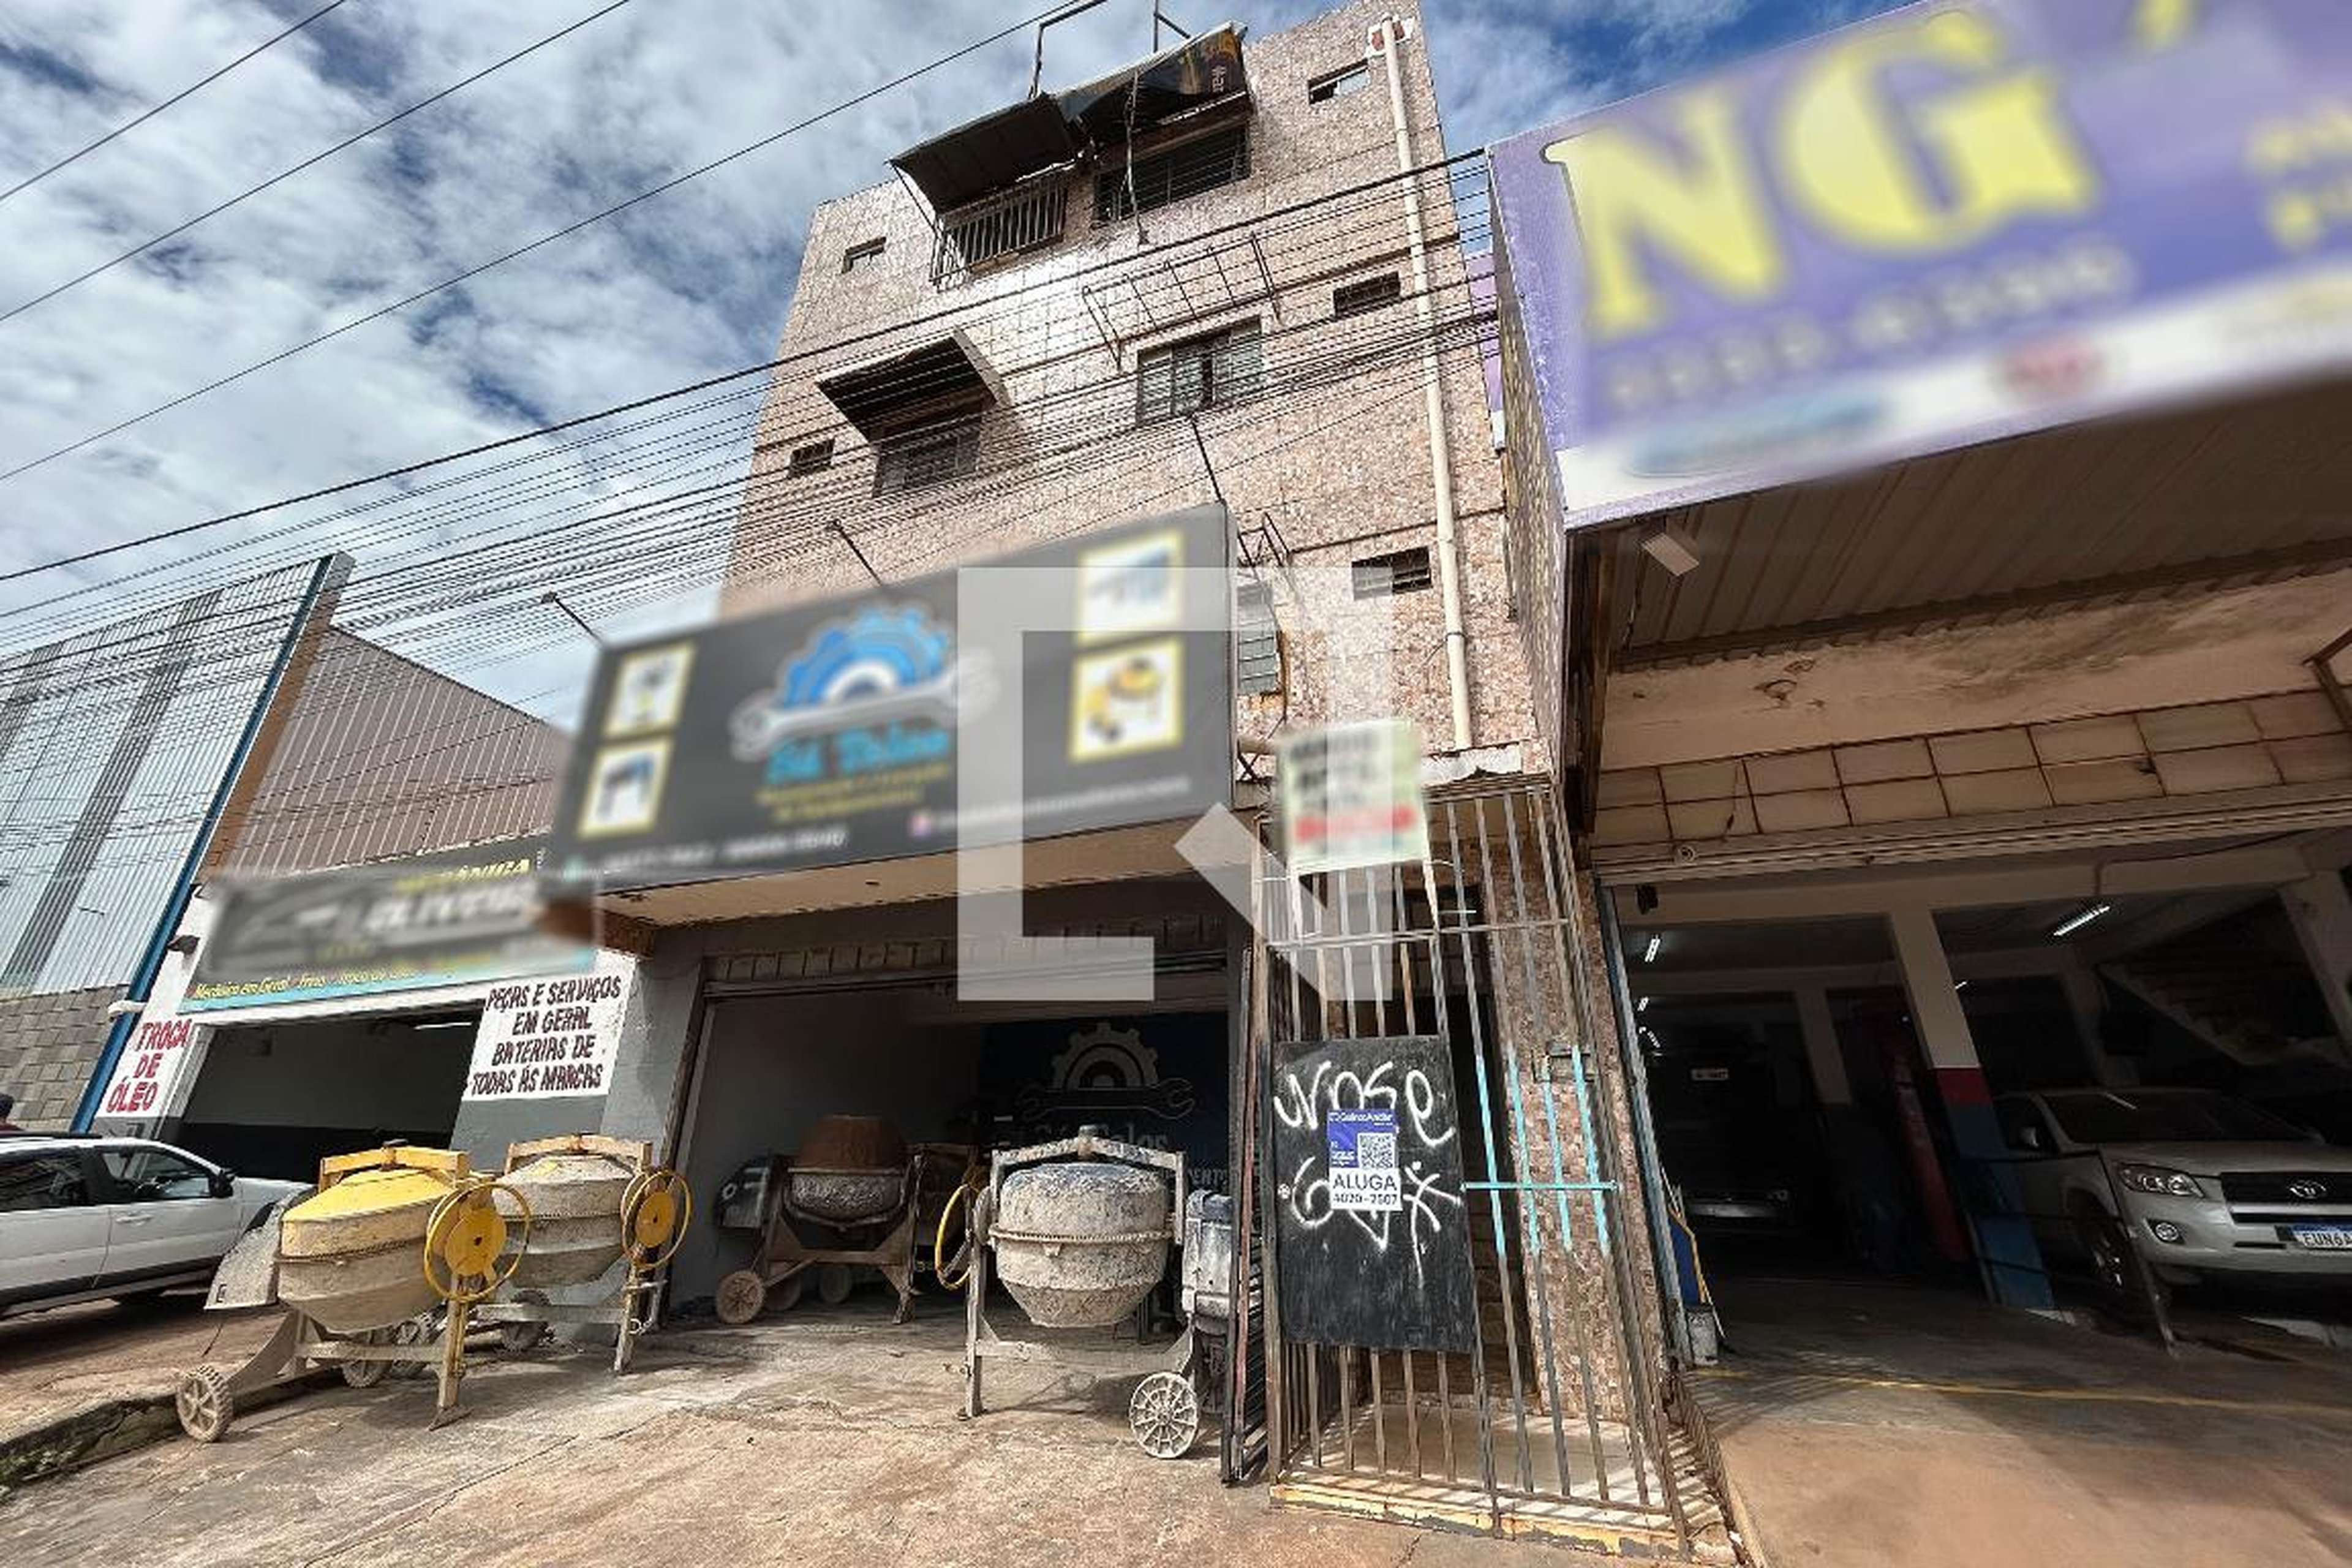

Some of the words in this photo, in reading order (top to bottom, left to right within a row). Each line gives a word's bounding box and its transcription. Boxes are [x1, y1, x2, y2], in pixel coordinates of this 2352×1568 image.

[486, 985, 530, 1012] PEÇAS
[532, 982, 546, 1007] E
[547, 975, 622, 1005] SERVIÇOS
[135, 1019, 192, 1052] TROCA
[512, 1011, 539, 1035] EM
[541, 1006, 593, 1033] GERAL
[133, 1053, 164, 1079] DE
[492, 1036, 568, 1066] BATERIAS
[571, 1034, 597, 1058] DE
[106, 1076, 158, 1113] ÓLEO
[472, 1068, 516, 1096] TODAS
[540, 1063, 603, 1091] MARCAS
[1332, 1173, 1398, 1191] ALUGA
